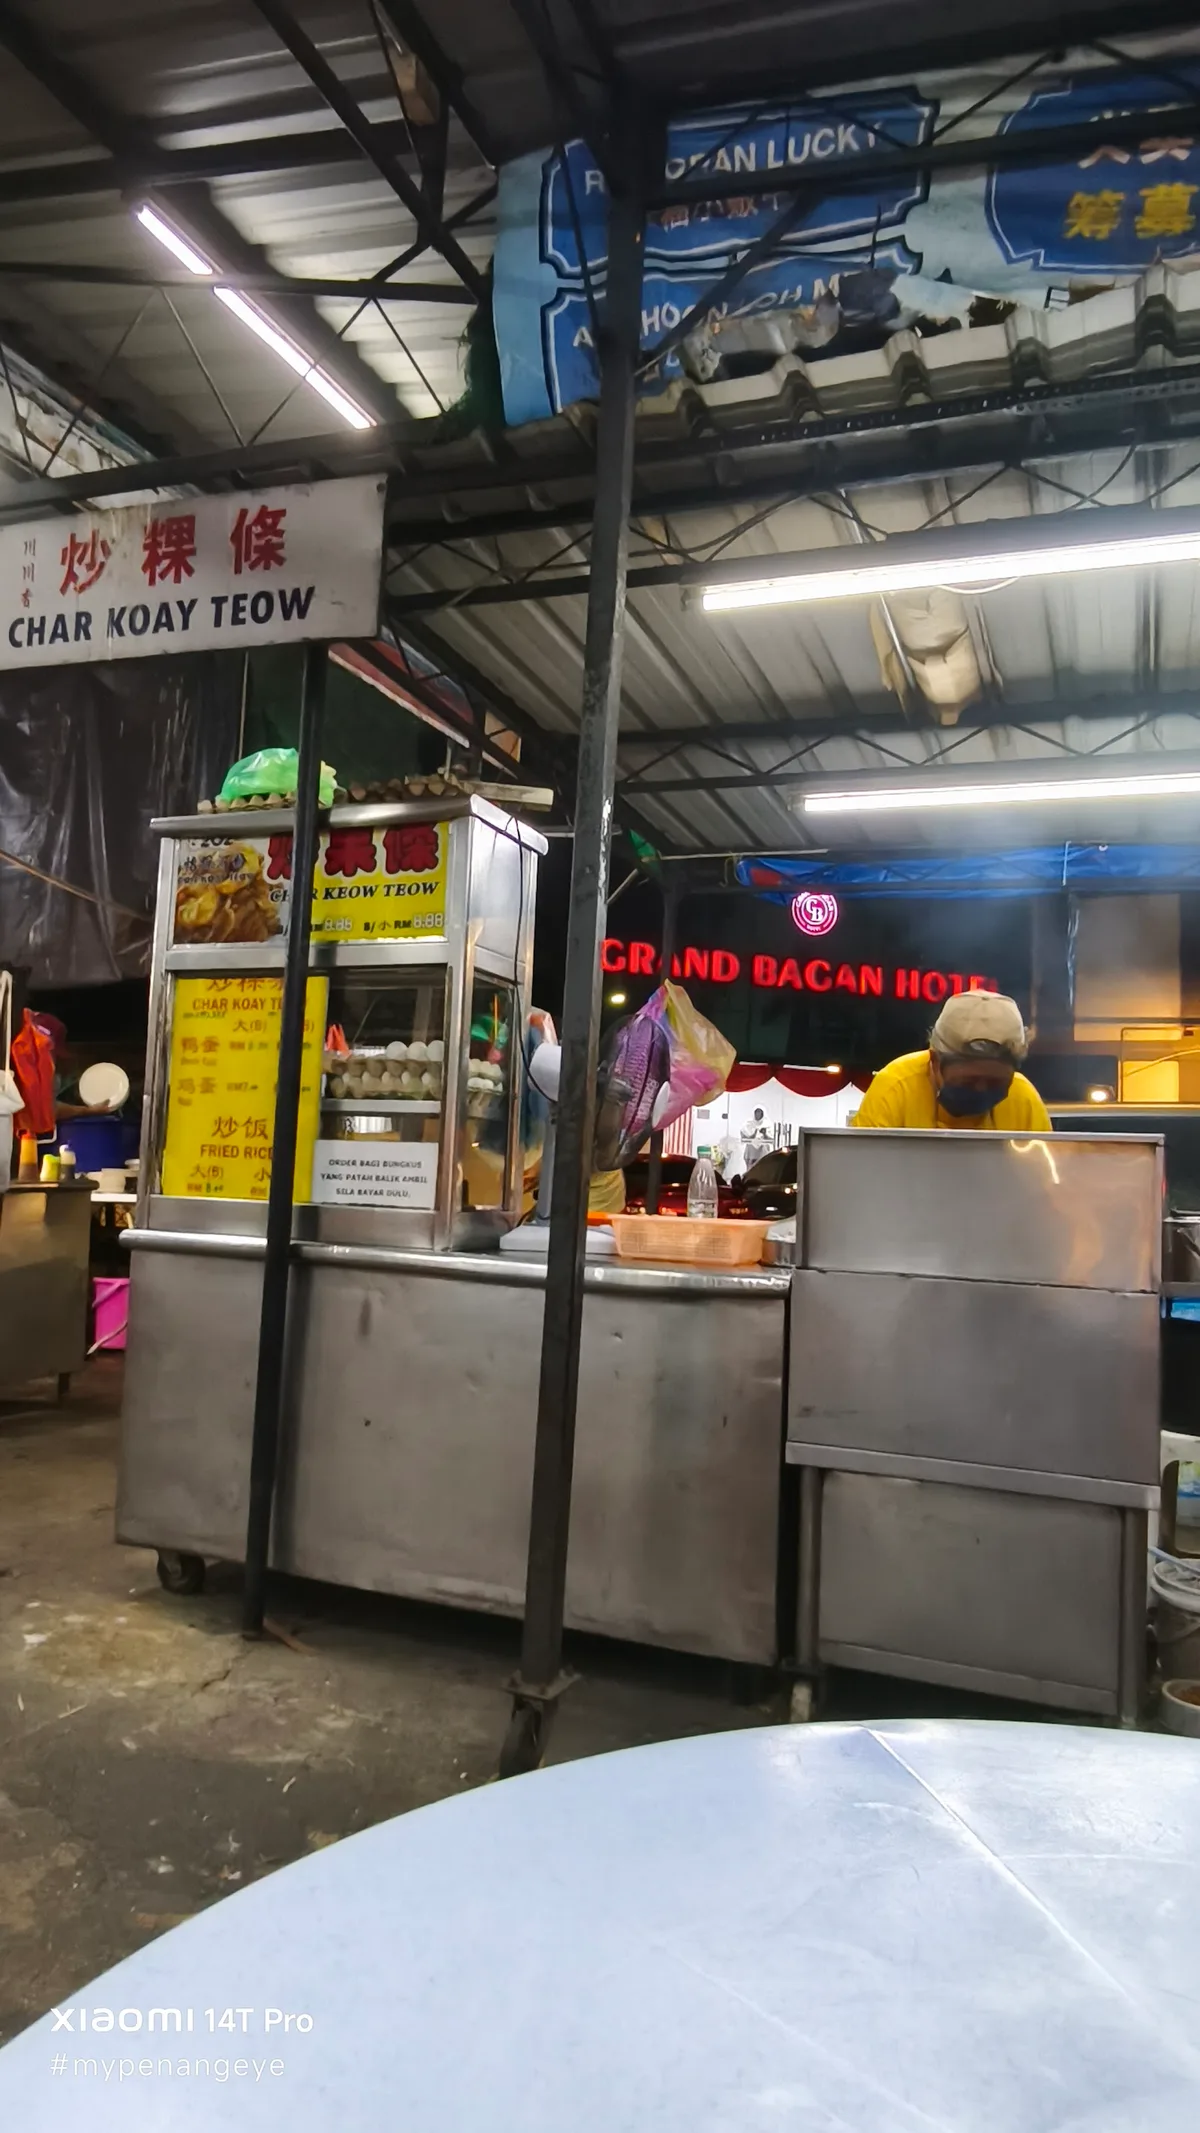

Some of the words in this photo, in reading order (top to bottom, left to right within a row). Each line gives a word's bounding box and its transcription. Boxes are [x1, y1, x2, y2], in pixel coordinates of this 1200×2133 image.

[584, 142, 757, 196] ROAN
[767, 122, 884, 167] LUCKY
[59, 504, 288, 597] 炒粿條
[8, 610, 92, 648] CHAR
[106, 598, 198, 638] KOAY
[210, 585, 316, 628] TEOW
[322, 884, 377, 900] KEOW
[382, 881, 439, 897] TEOW
[601, 938, 740, 983] GRAND
[192, 998, 228, 1010] CHAR
[232, 998, 266, 1010] KOAY
[211, 1116, 268, 1140] 炒饭
[200, 1144, 239, 1158] FRIED
[328, 1159, 357, 1167] ORDER
[360, 1160, 380, 1168] BAGI
[321, 1173, 343, 1181] YANG
[375, 1175, 400, 1183] BALIK
